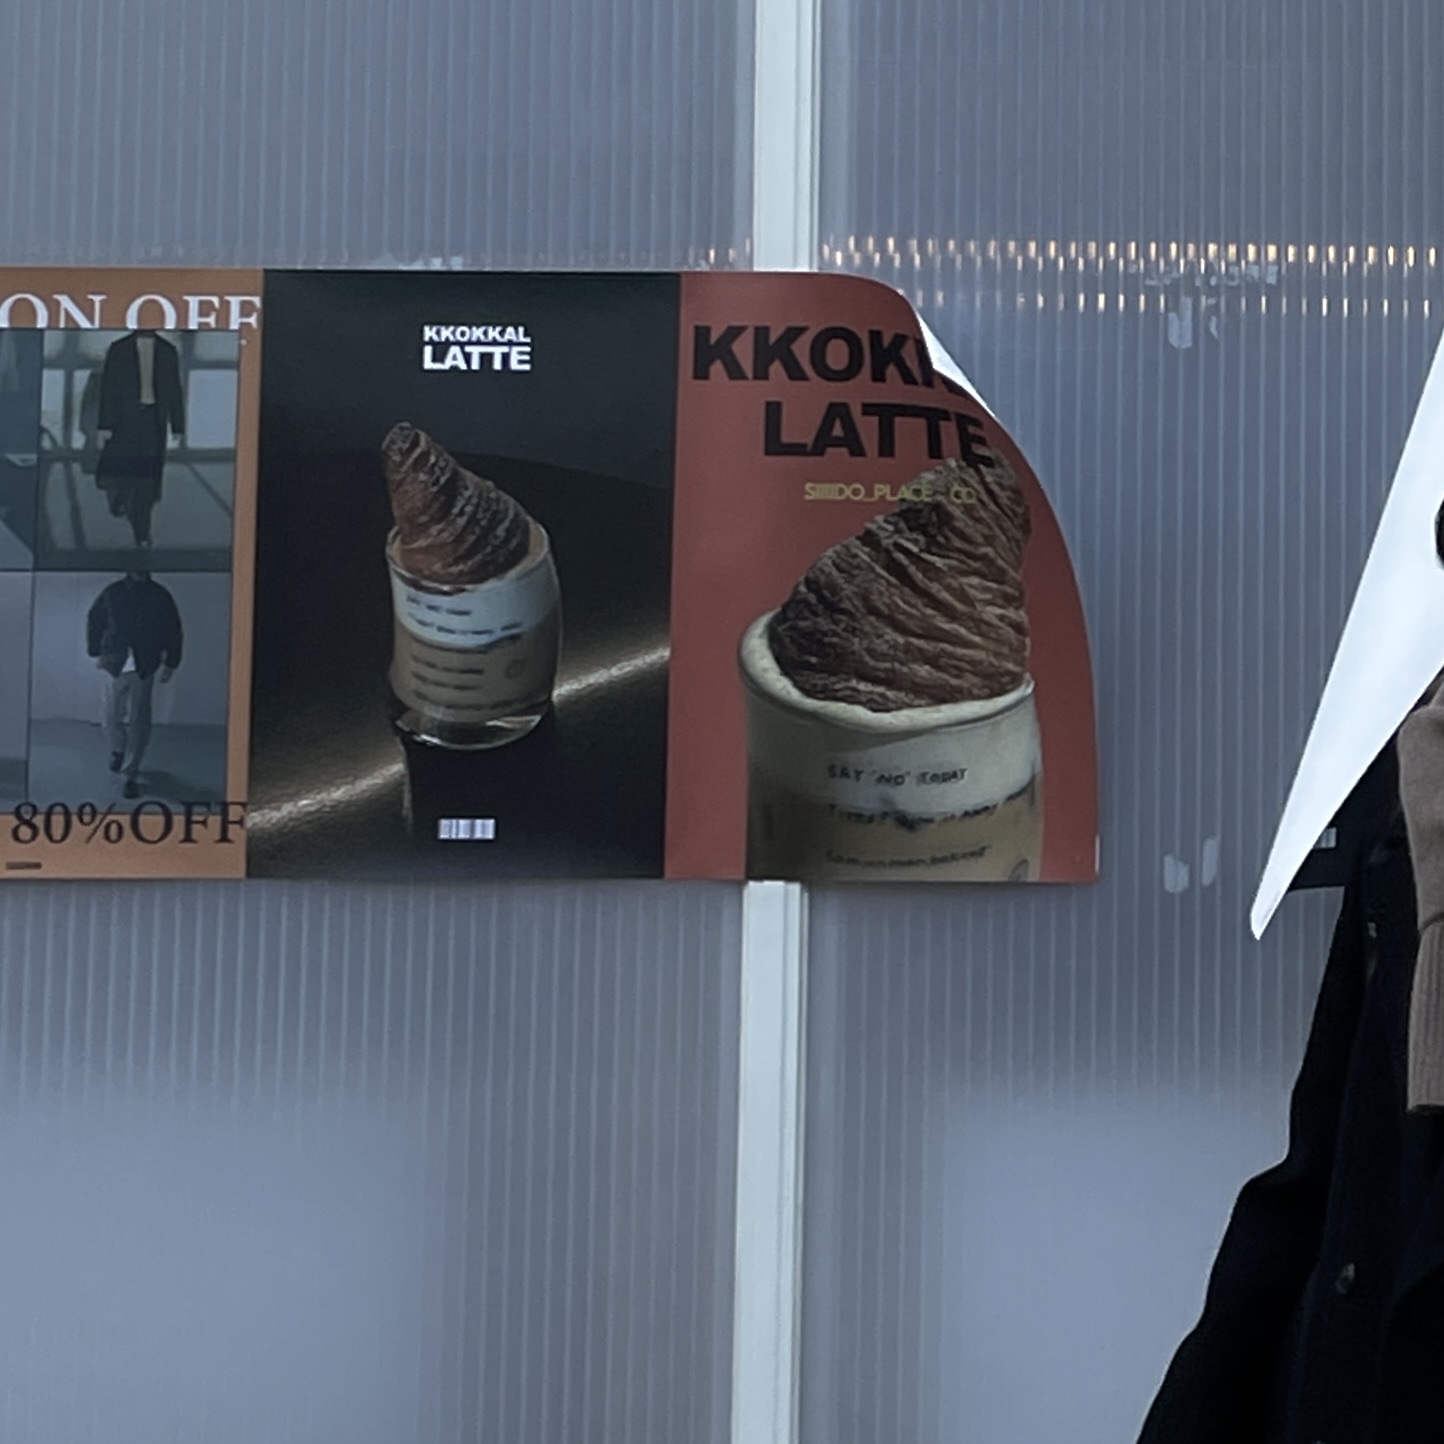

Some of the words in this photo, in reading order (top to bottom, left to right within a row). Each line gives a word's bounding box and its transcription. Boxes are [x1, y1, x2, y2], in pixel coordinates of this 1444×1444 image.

[126, 294, 261, 329] OFF
[423, 324, 531, 342] KKOKKAL
[423, 345, 531, 371] LATTE
[764, 401, 995, 467] LATTE
[11, 801, 248, 845] 80%OFF
